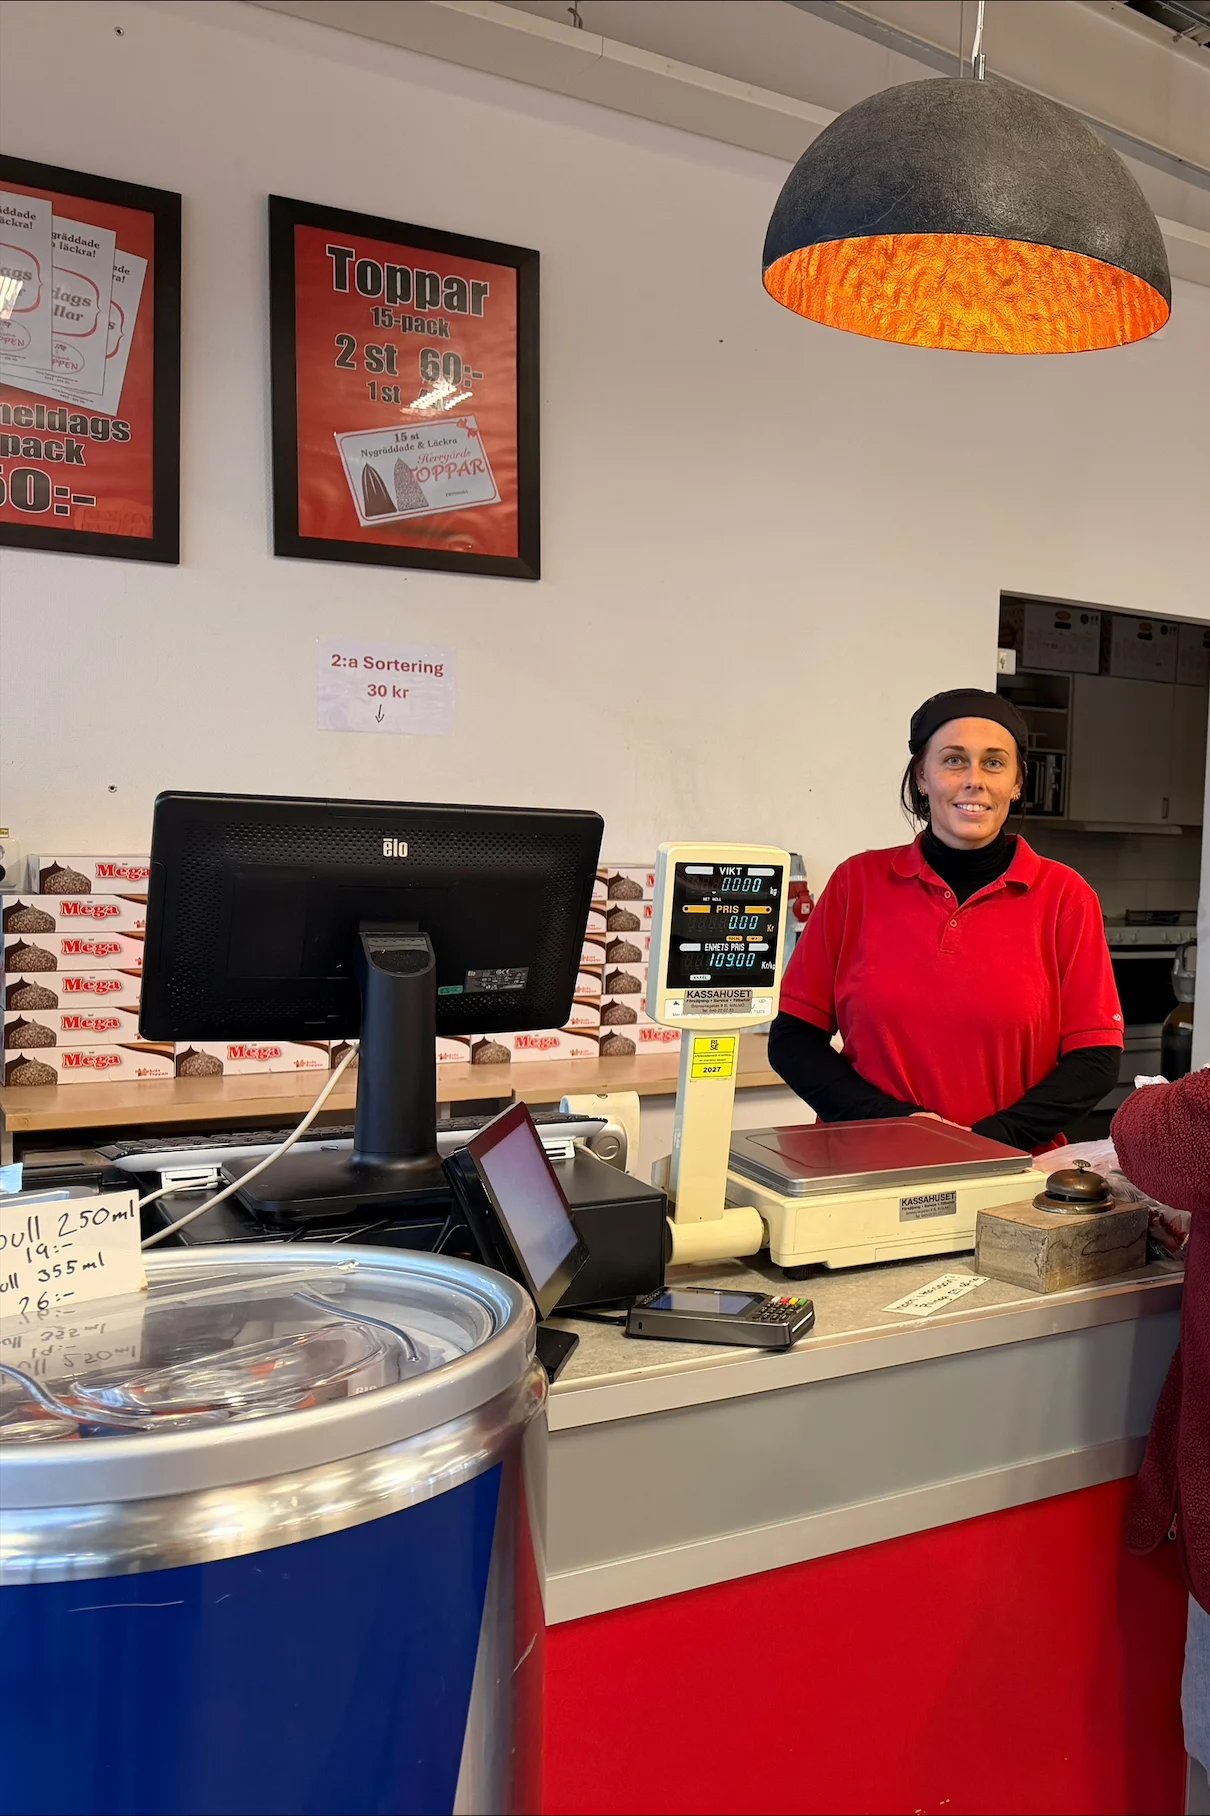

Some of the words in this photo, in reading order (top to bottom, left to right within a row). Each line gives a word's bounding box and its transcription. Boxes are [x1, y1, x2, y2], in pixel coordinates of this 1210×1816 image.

[326, 244, 489, 318] Toppar
[370, 306, 450, 338] 15-pack
[334, 333, 357, 370] 2
[364, 343, 399, 376] st
[419, 347, 484, 388] 60:-
[366, 381, 377, 401] 1
[381, 385, 401, 404] st
[393, 432, 408, 443] 15
[410, 432, 420, 440] st
[0, 432, 86, 466] pack
[409, 458, 486, 484] TOPPAR
[331, 653, 358, 668] 2:a
[363, 655, 444, 677] Sortering
[367, 683, 387, 697] 30
[392, 685, 409, 699] kr
[96, 862, 150, 880] Mega
[719, 867, 742, 875] VIKT
[60, 901, 119, 918] Mega
[716, 905, 739, 913] PRIS
[767, 924, 774, 932] Kr
[61, 938, 120, 957] Mega
[705, 943, 729, 951] ENHETS
[731, 943, 745, 951] PRIS
[63, 977, 121, 994] Mega
[687, 990, 751, 999] KASSAHUSET
[62, 1014, 120, 1032] Mega
[515, 1034, 559, 1050] Mega
[639, 1028, 680, 1043] Mega
[63, 1052, 120, 1069] Mega
[227, 1044, 280, 1060] Mega
[902, 1193, 955, 1206] KASSAHUSET
[27, 1243, 73, 1263] 19:-
